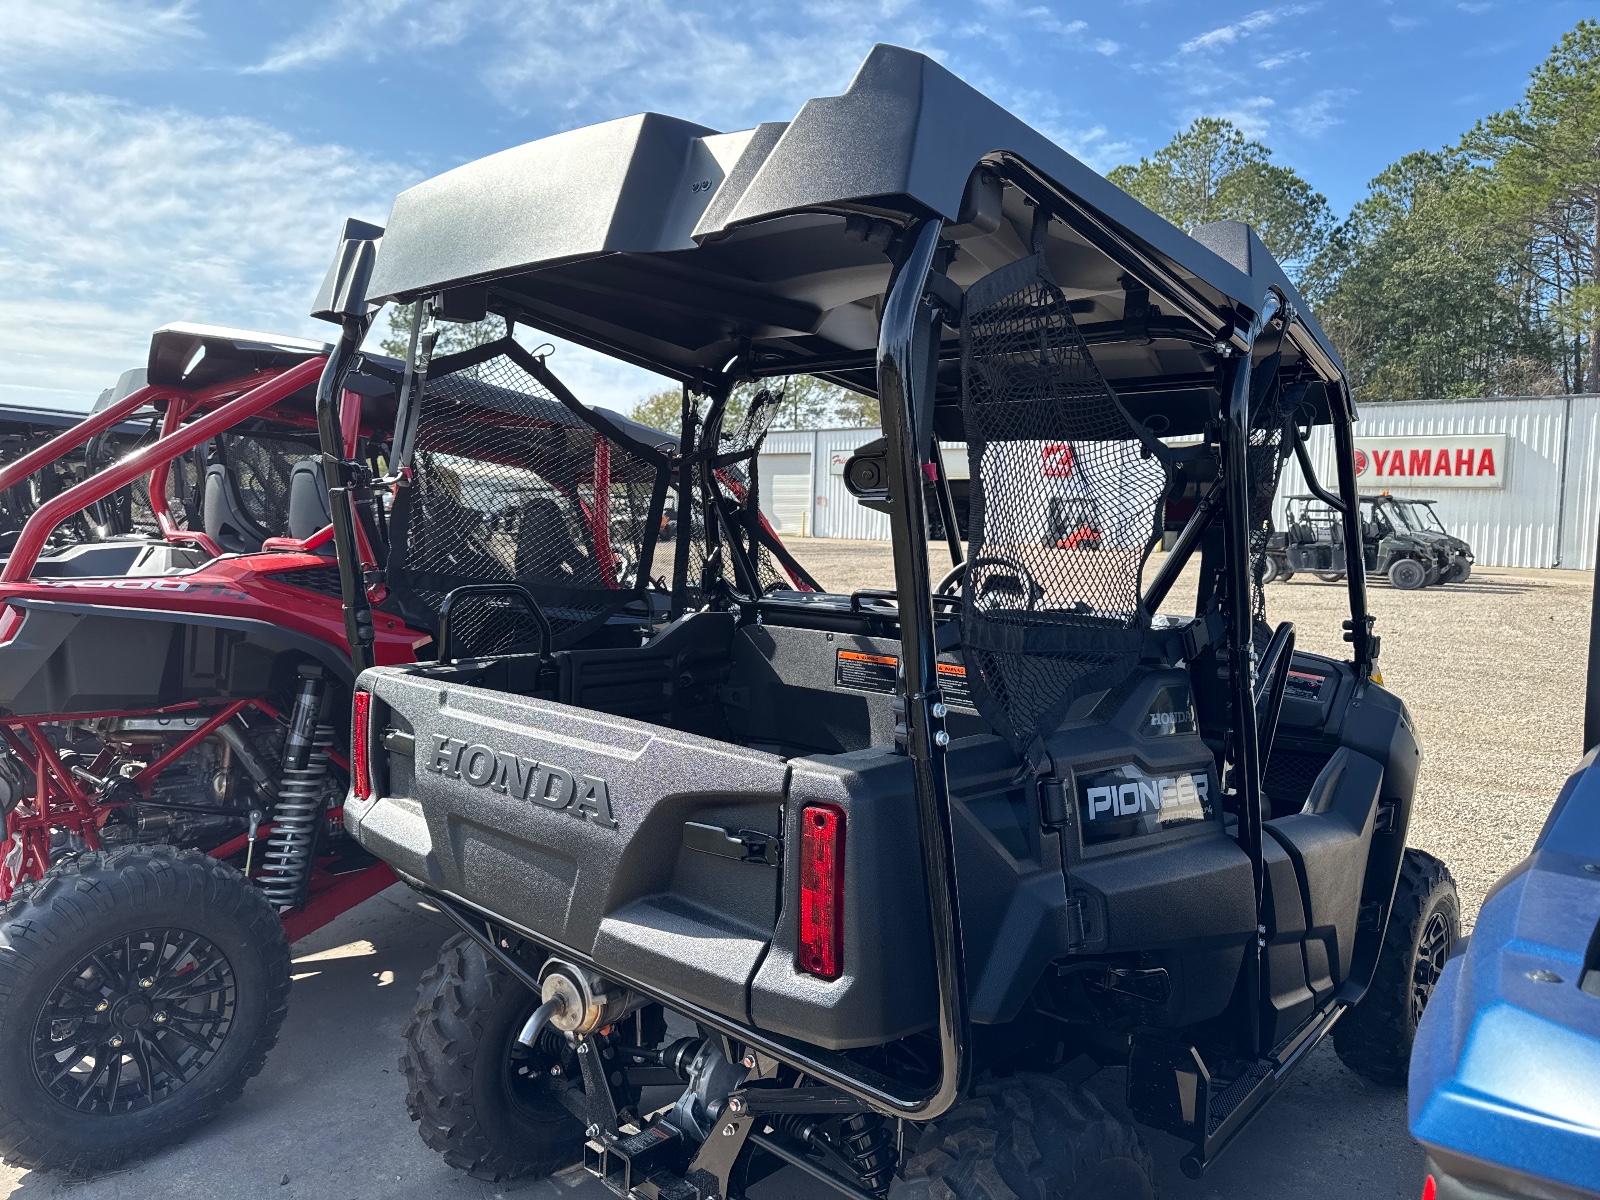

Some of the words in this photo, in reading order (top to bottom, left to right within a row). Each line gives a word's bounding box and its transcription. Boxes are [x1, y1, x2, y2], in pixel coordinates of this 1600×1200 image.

[1372, 448, 1496, 477] YAMAHA
[1150, 711, 1192, 726] HONDA
[425, 733, 619, 829] HONDA
[1087, 773, 1209, 820] PIONEER
